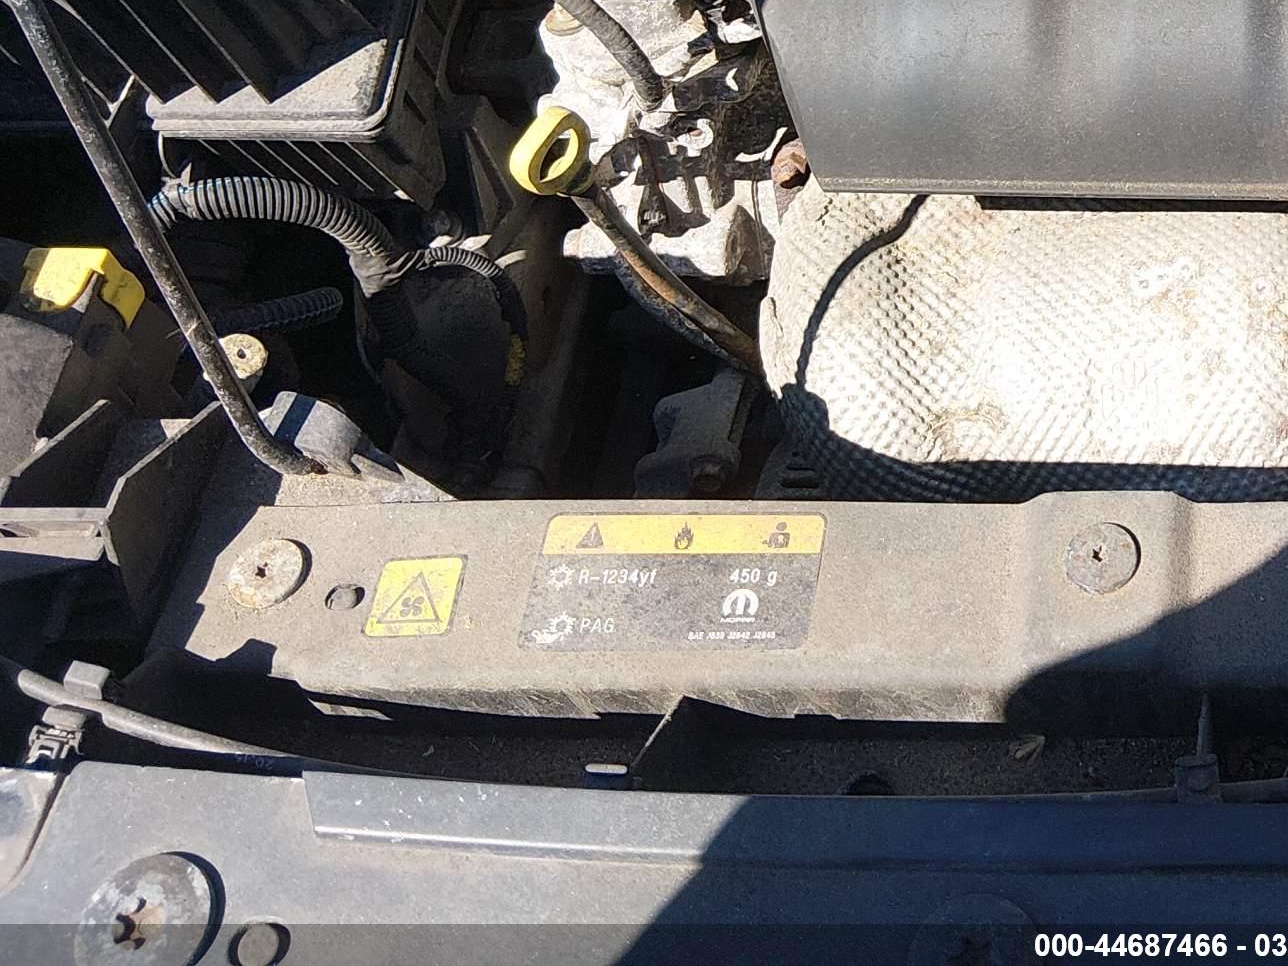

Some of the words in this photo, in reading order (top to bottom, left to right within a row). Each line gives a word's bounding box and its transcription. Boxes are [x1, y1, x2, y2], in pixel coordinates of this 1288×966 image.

[578, 568, 658, 588] R-1234yf
[729, 568, 761, 584] 450
[767, 571, 778, 586] g
[580, 617, 616, 634] PAG
